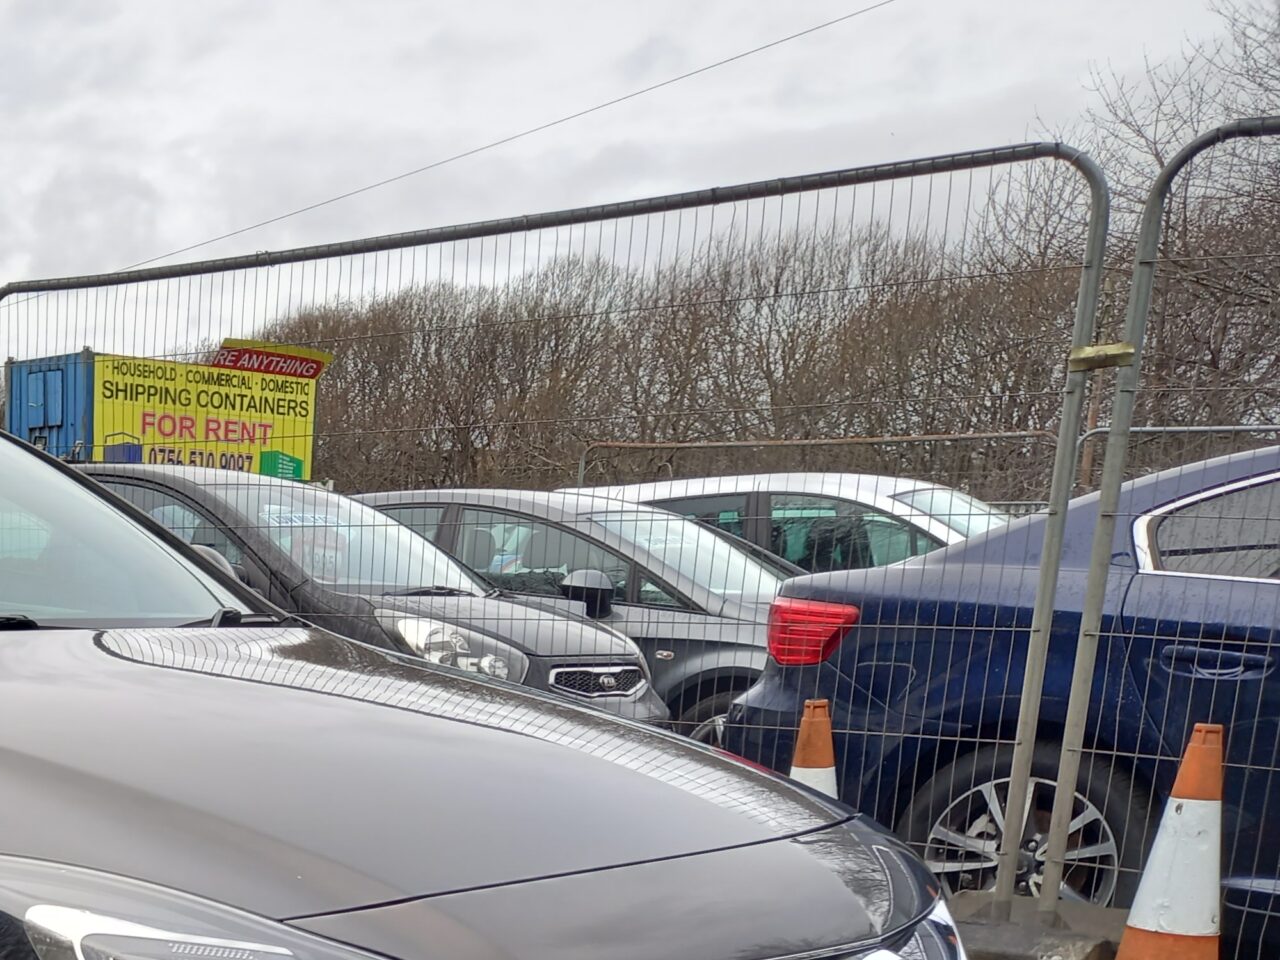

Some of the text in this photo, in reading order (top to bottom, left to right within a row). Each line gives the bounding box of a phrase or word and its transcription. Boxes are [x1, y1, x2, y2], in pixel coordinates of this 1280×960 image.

[112, 361, 310, 396] HOUSEHOLD COMMERCIAL DOMESTIC
[237, 354, 317, 376] ANYTHING
[102, 380, 309, 418] SHIPPING CONTAINERS
[141, 412, 272, 445] FOR RENT
